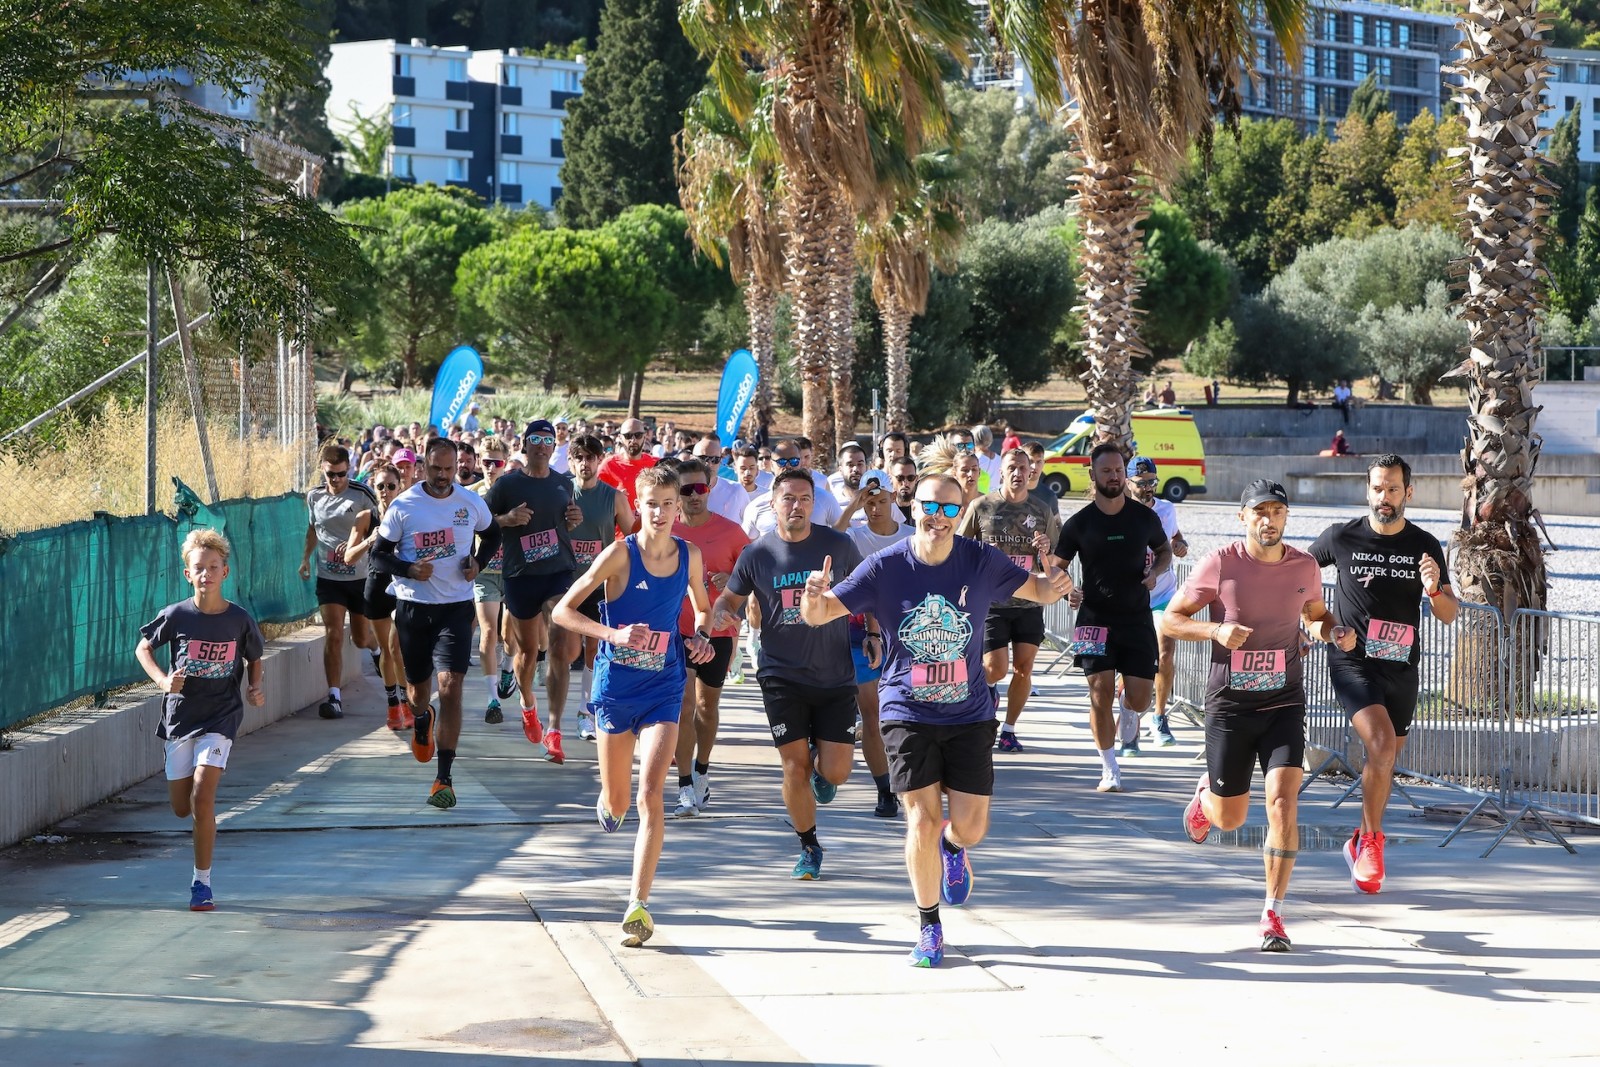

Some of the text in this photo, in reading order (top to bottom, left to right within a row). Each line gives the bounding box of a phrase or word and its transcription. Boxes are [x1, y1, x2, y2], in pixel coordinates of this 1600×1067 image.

[1159, 442, 1175, 451] 194
[422, 529, 446, 547] 633
[528, 531, 551, 549] 033
[574, 541, 596, 554] 506
[1351, 551, 1415, 565] NIKAD GORI
[1350, 565, 1416, 579] UVIJEK DOLI
[912, 628, 960, 641] RUNNING
[1077, 627, 1101, 641] 050
[1377, 622, 1408, 643] 057
[197, 642, 229, 661] 562
[922, 641, 948, 656] HERO
[1242, 651, 1276, 671] 029
[925, 661, 955, 685] 001
